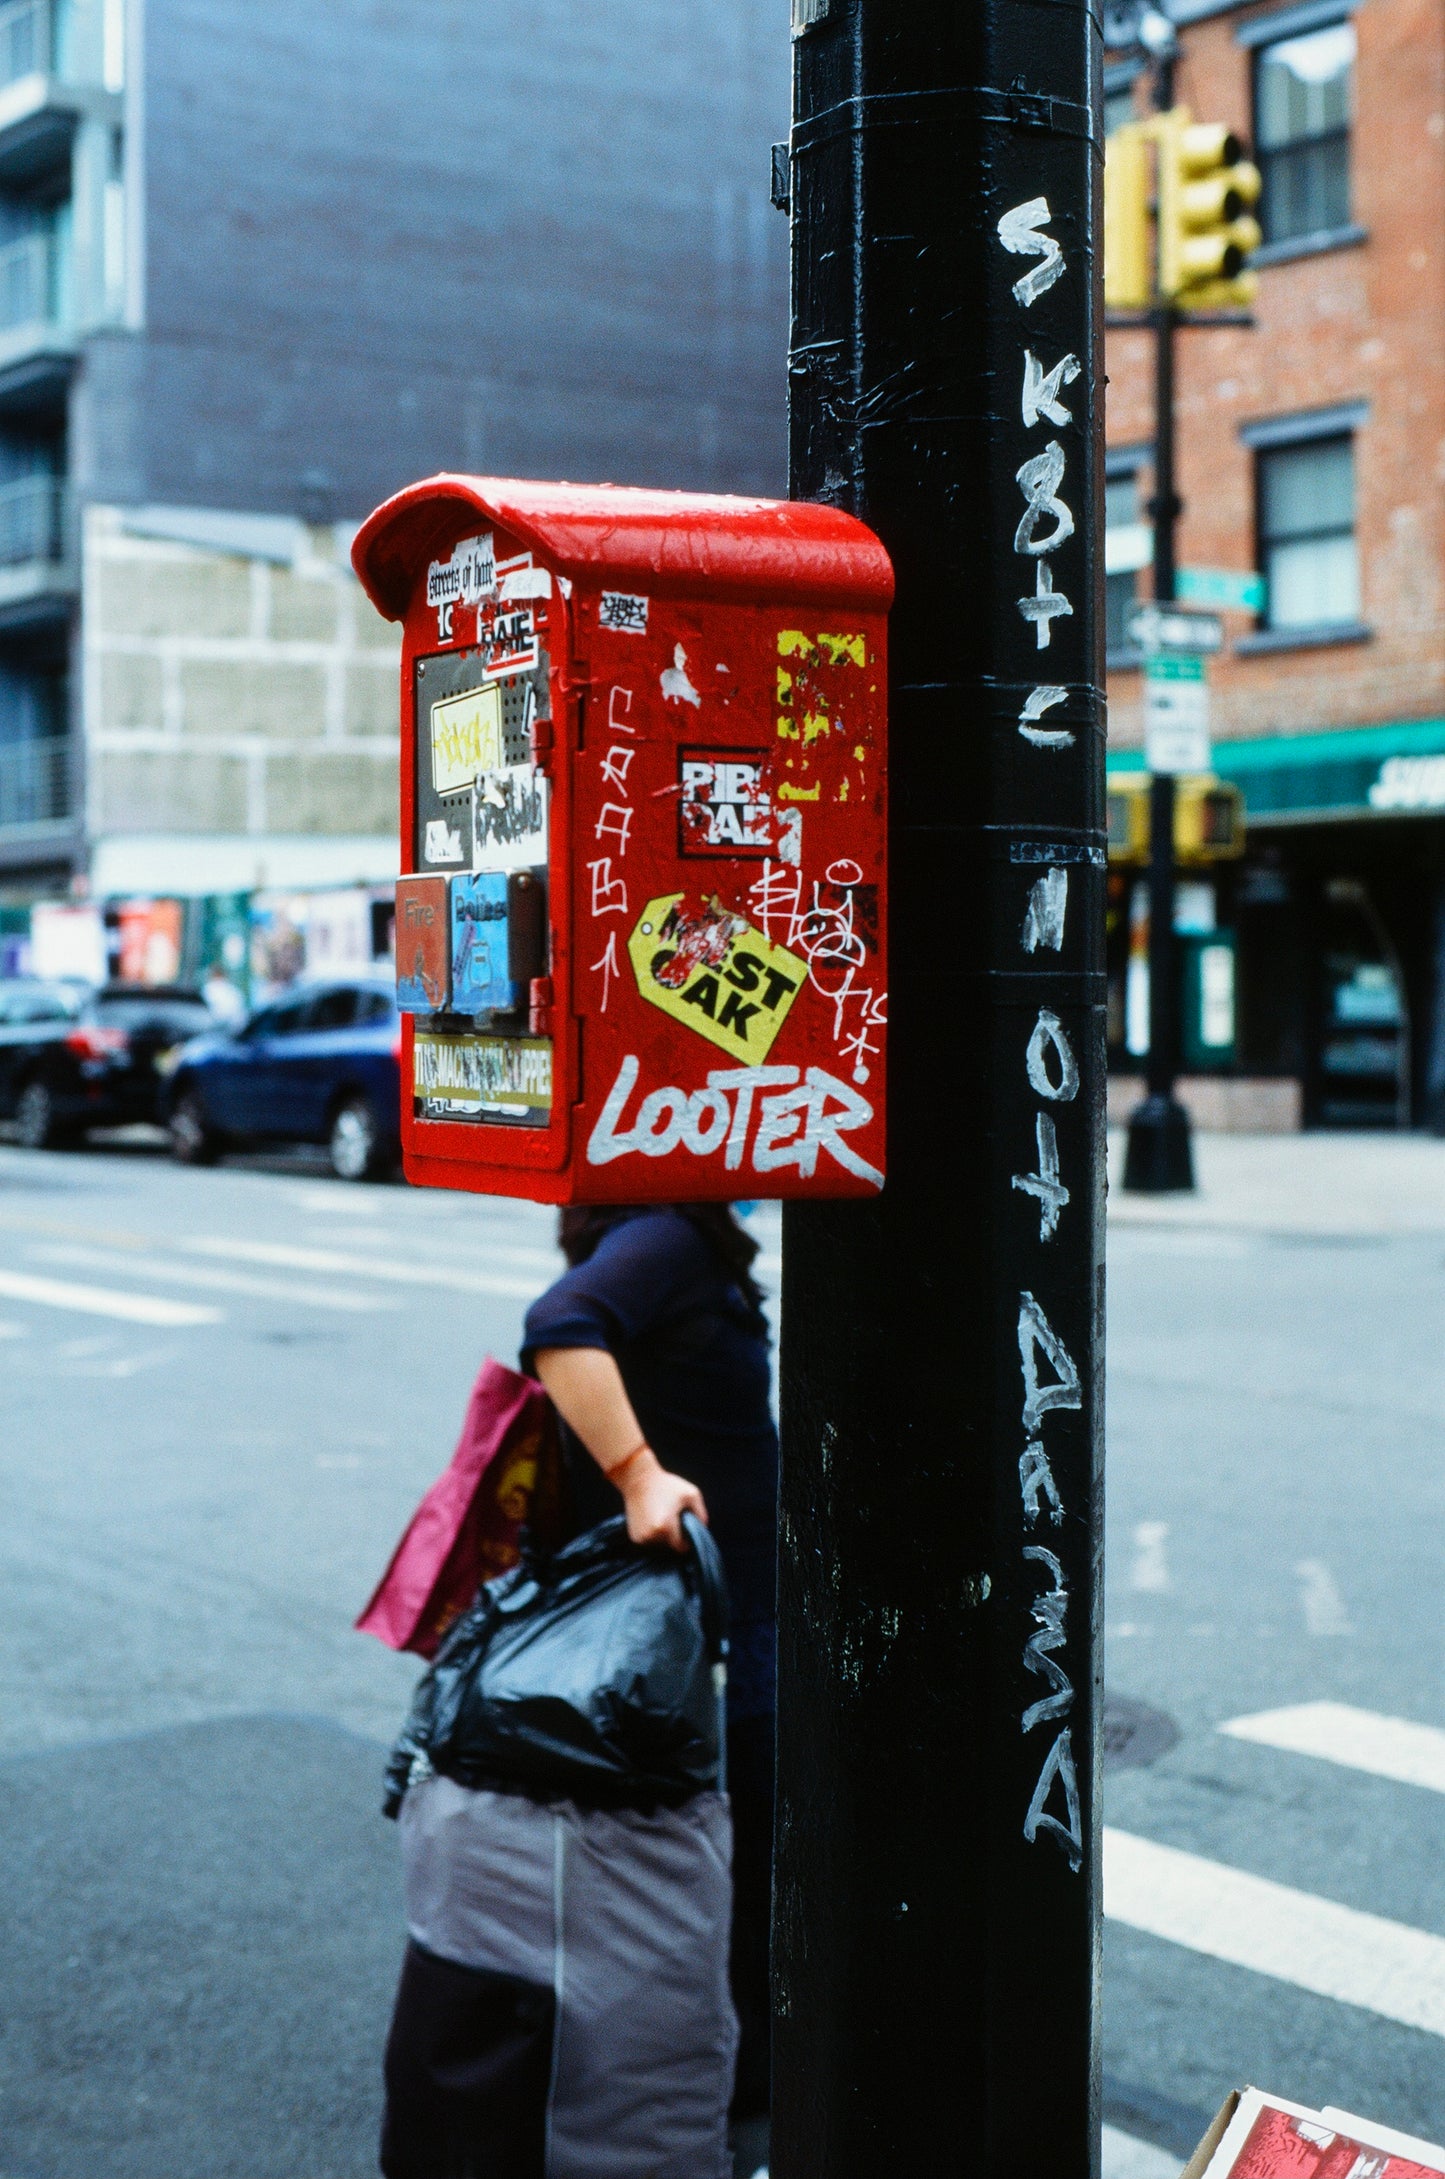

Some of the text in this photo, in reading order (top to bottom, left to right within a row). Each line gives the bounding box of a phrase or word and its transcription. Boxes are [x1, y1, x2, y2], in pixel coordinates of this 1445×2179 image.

[405, 897, 435, 928] Fire
[455, 893, 508, 922] Police
[586, 1054, 885, 1192] LOOTER
